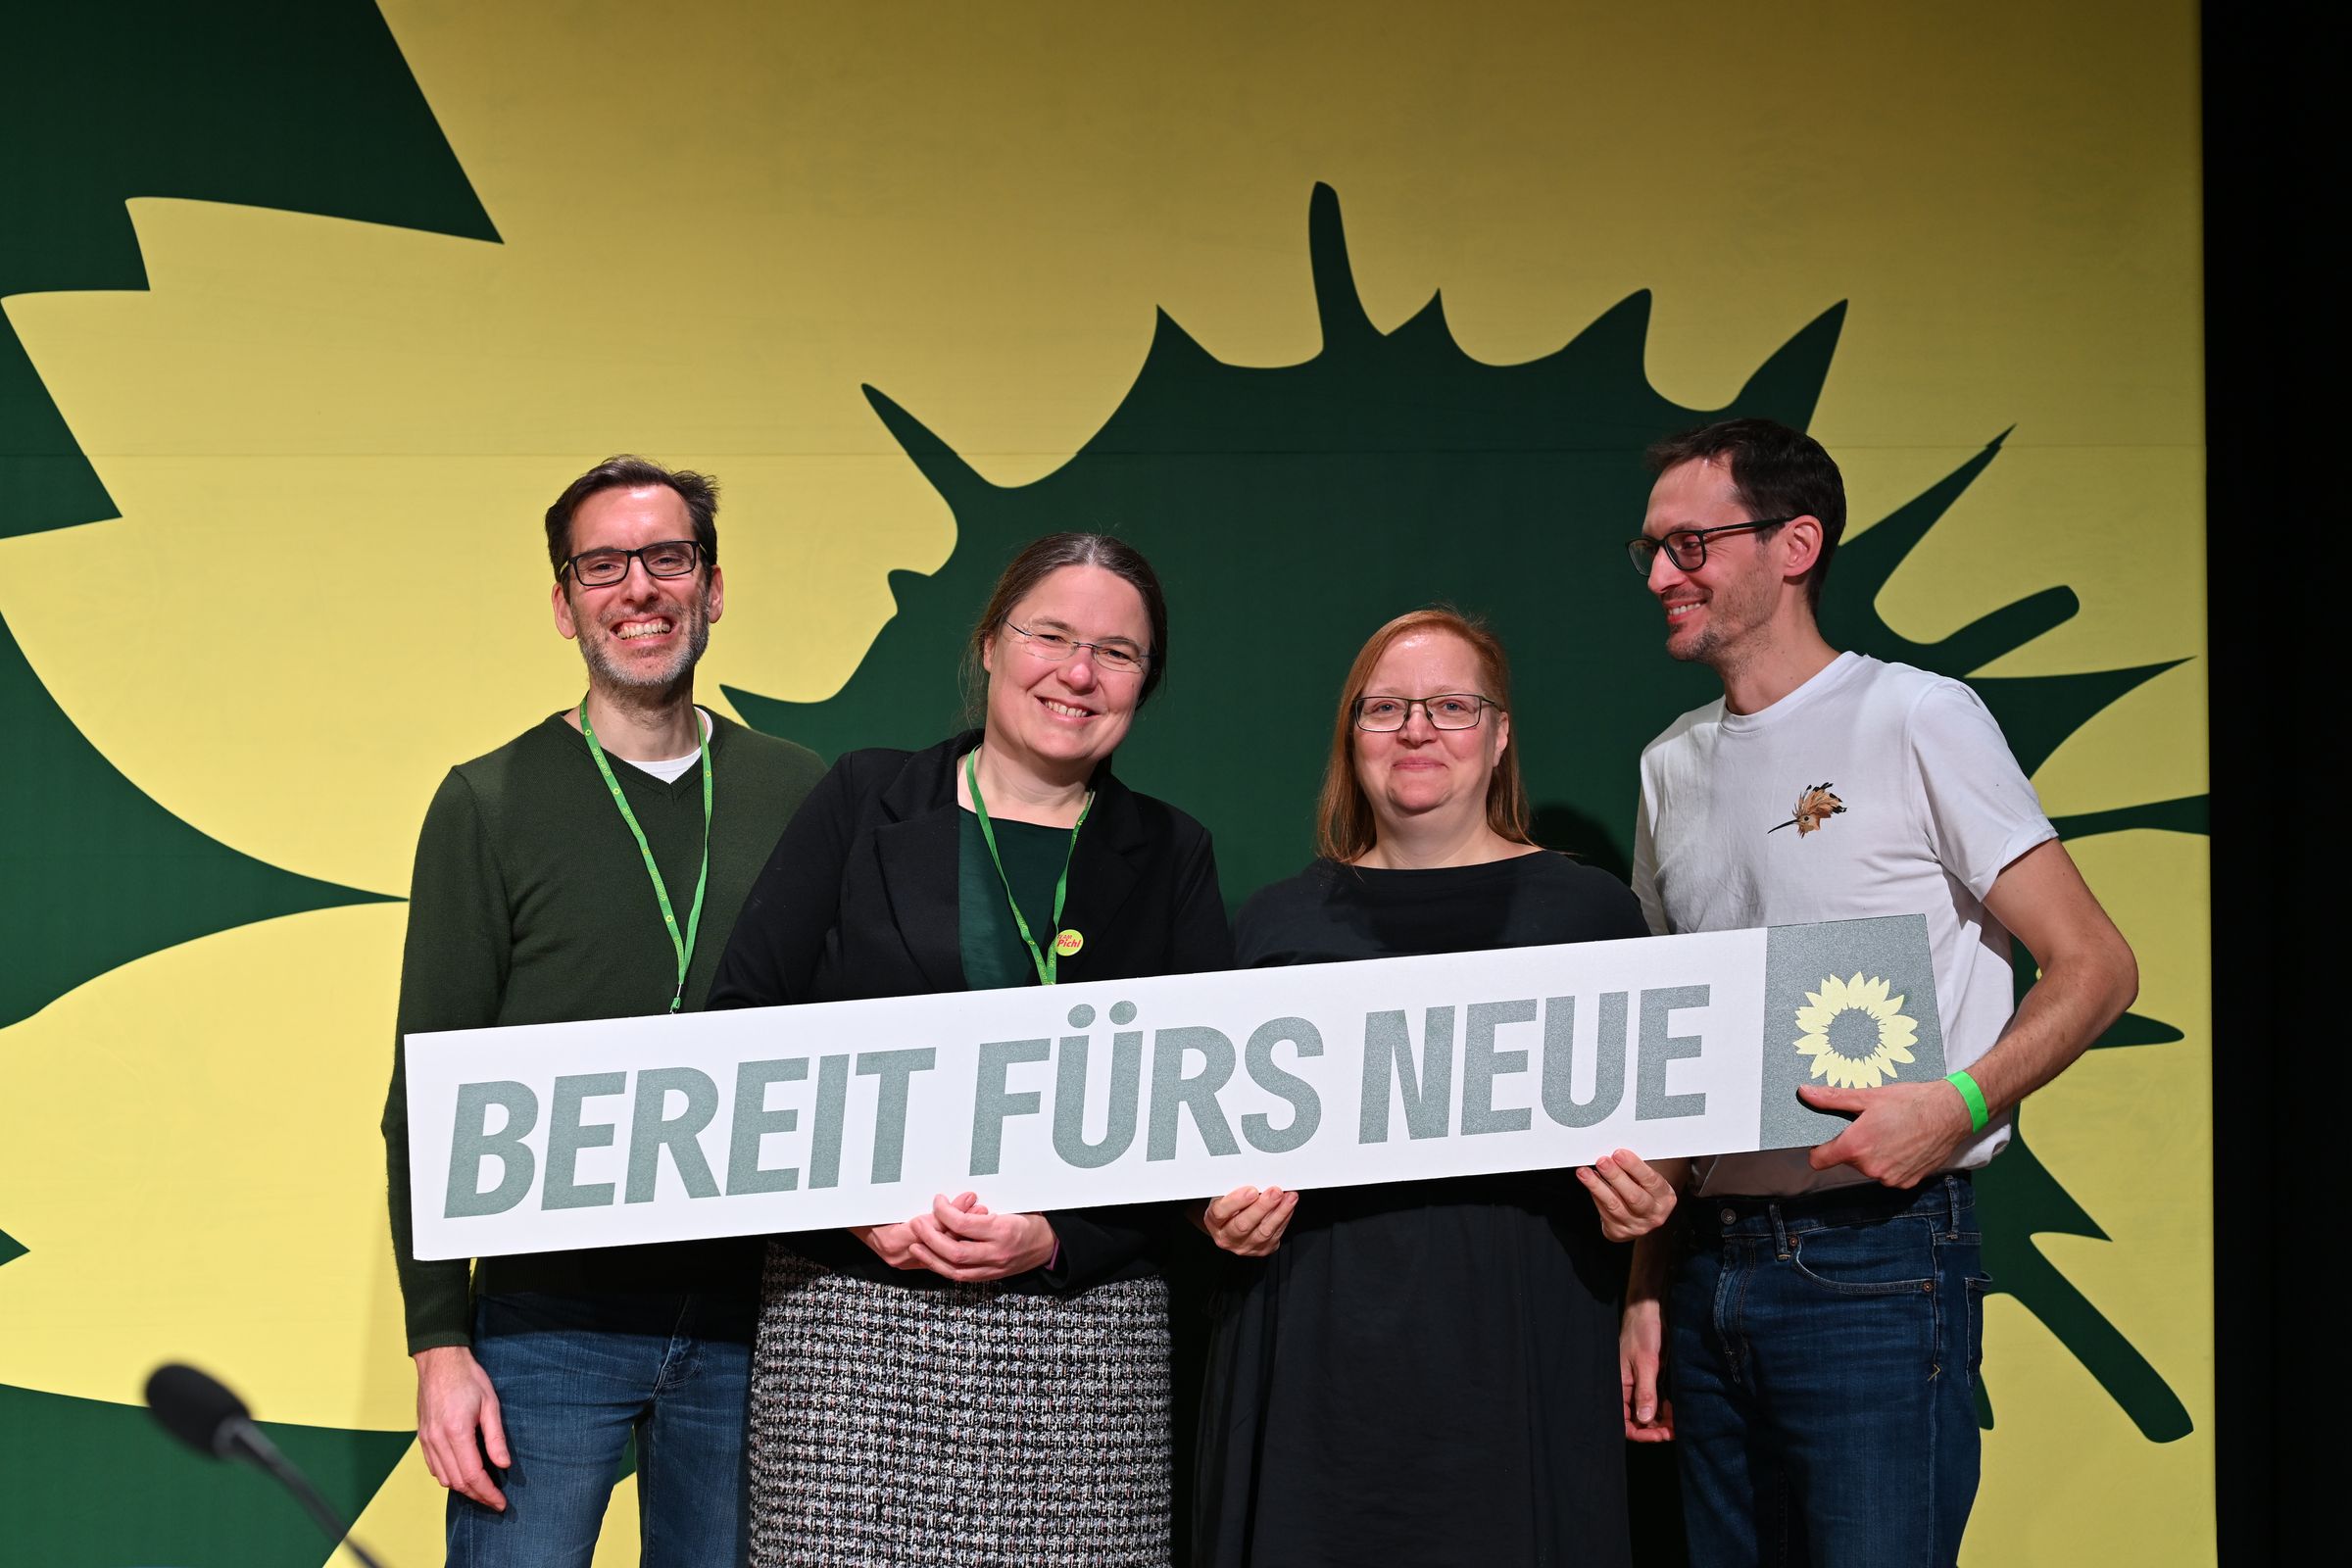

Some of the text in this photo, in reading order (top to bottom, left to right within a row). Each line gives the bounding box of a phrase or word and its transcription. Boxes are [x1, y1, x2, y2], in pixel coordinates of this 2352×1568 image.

[592, 747, 611, 777] gruene.de
[1056, 939, 1082, 948] Pichl
[444, 984, 1710, 1218] BEREIT FÜRS NEUE
